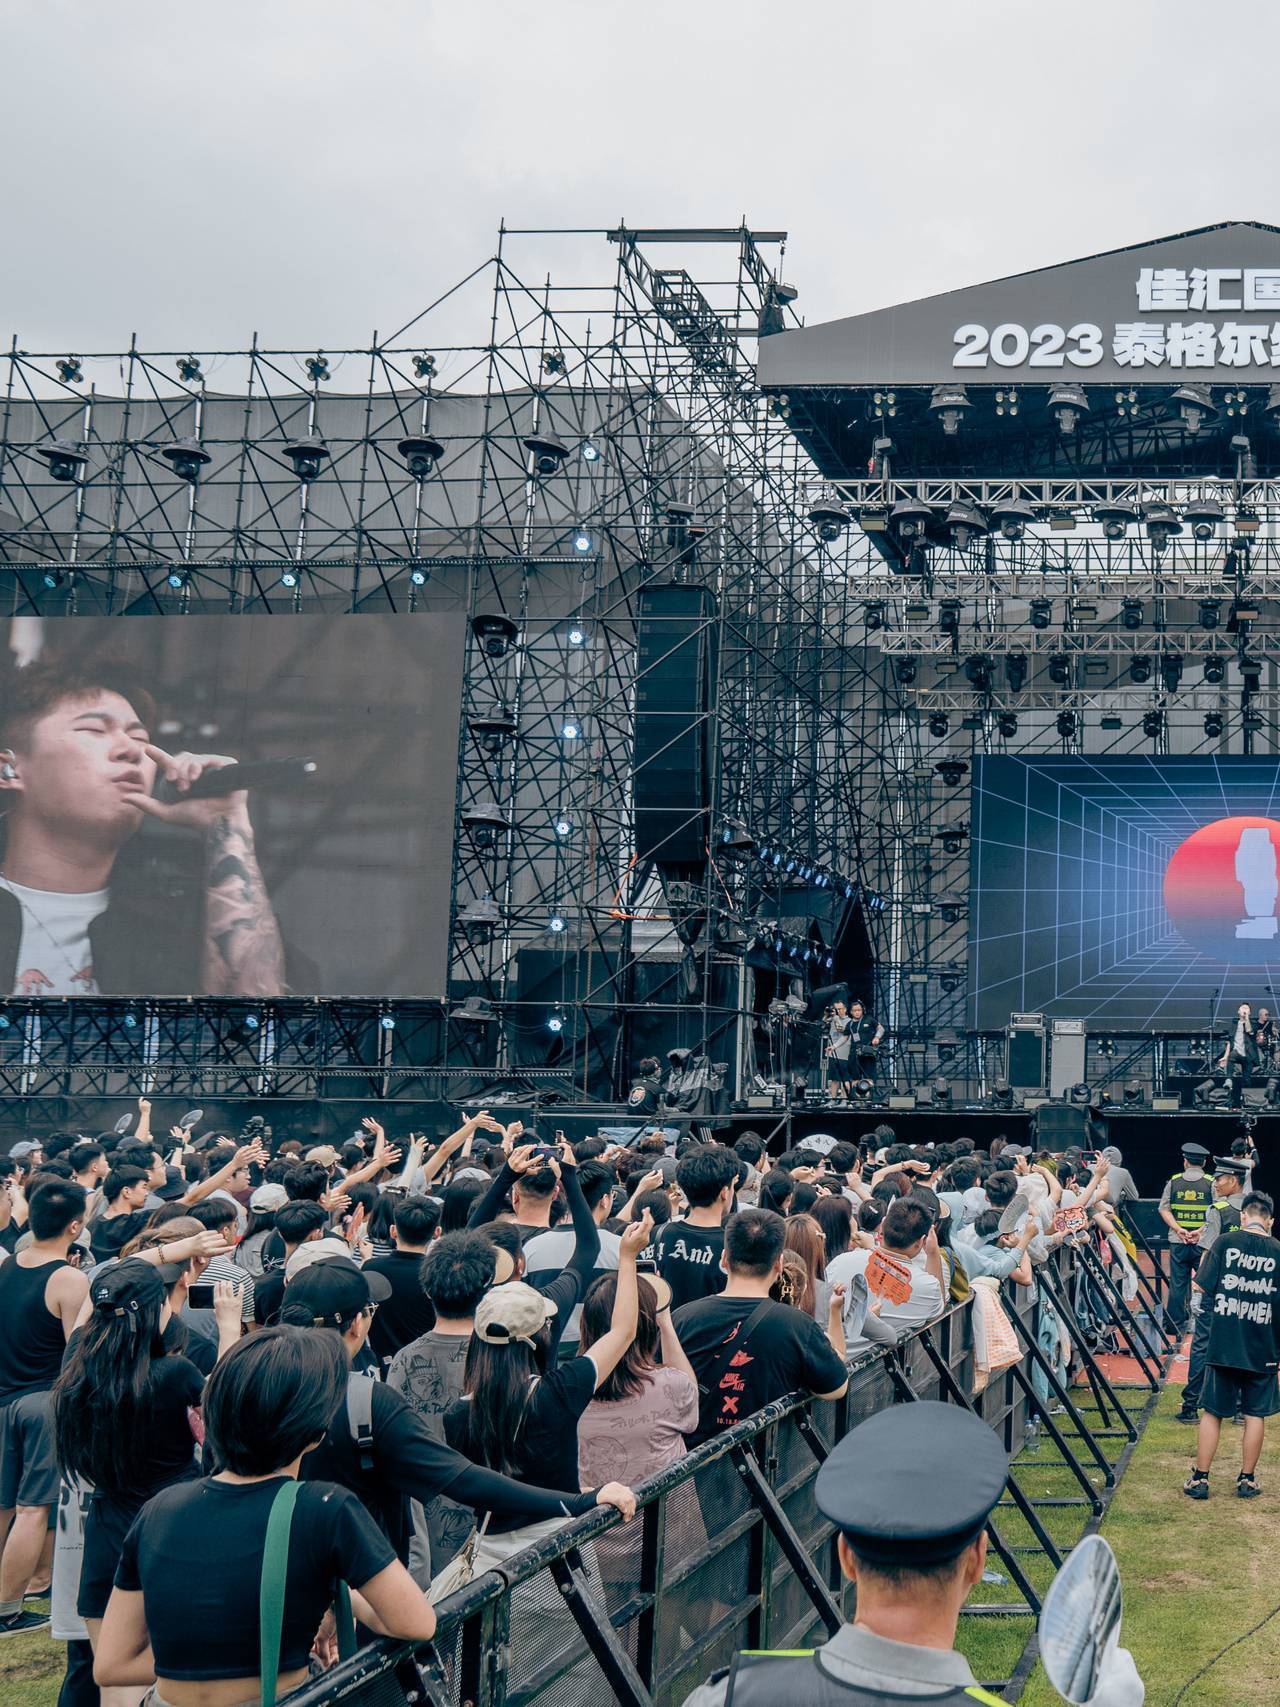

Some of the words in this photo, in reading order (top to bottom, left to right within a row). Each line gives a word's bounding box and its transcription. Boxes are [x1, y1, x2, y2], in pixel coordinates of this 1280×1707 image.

[668, 1239, 714, 1265] And
[1225, 1247, 1276, 1273] PHOTO
[722, 1372, 741, 1382] NIKE
